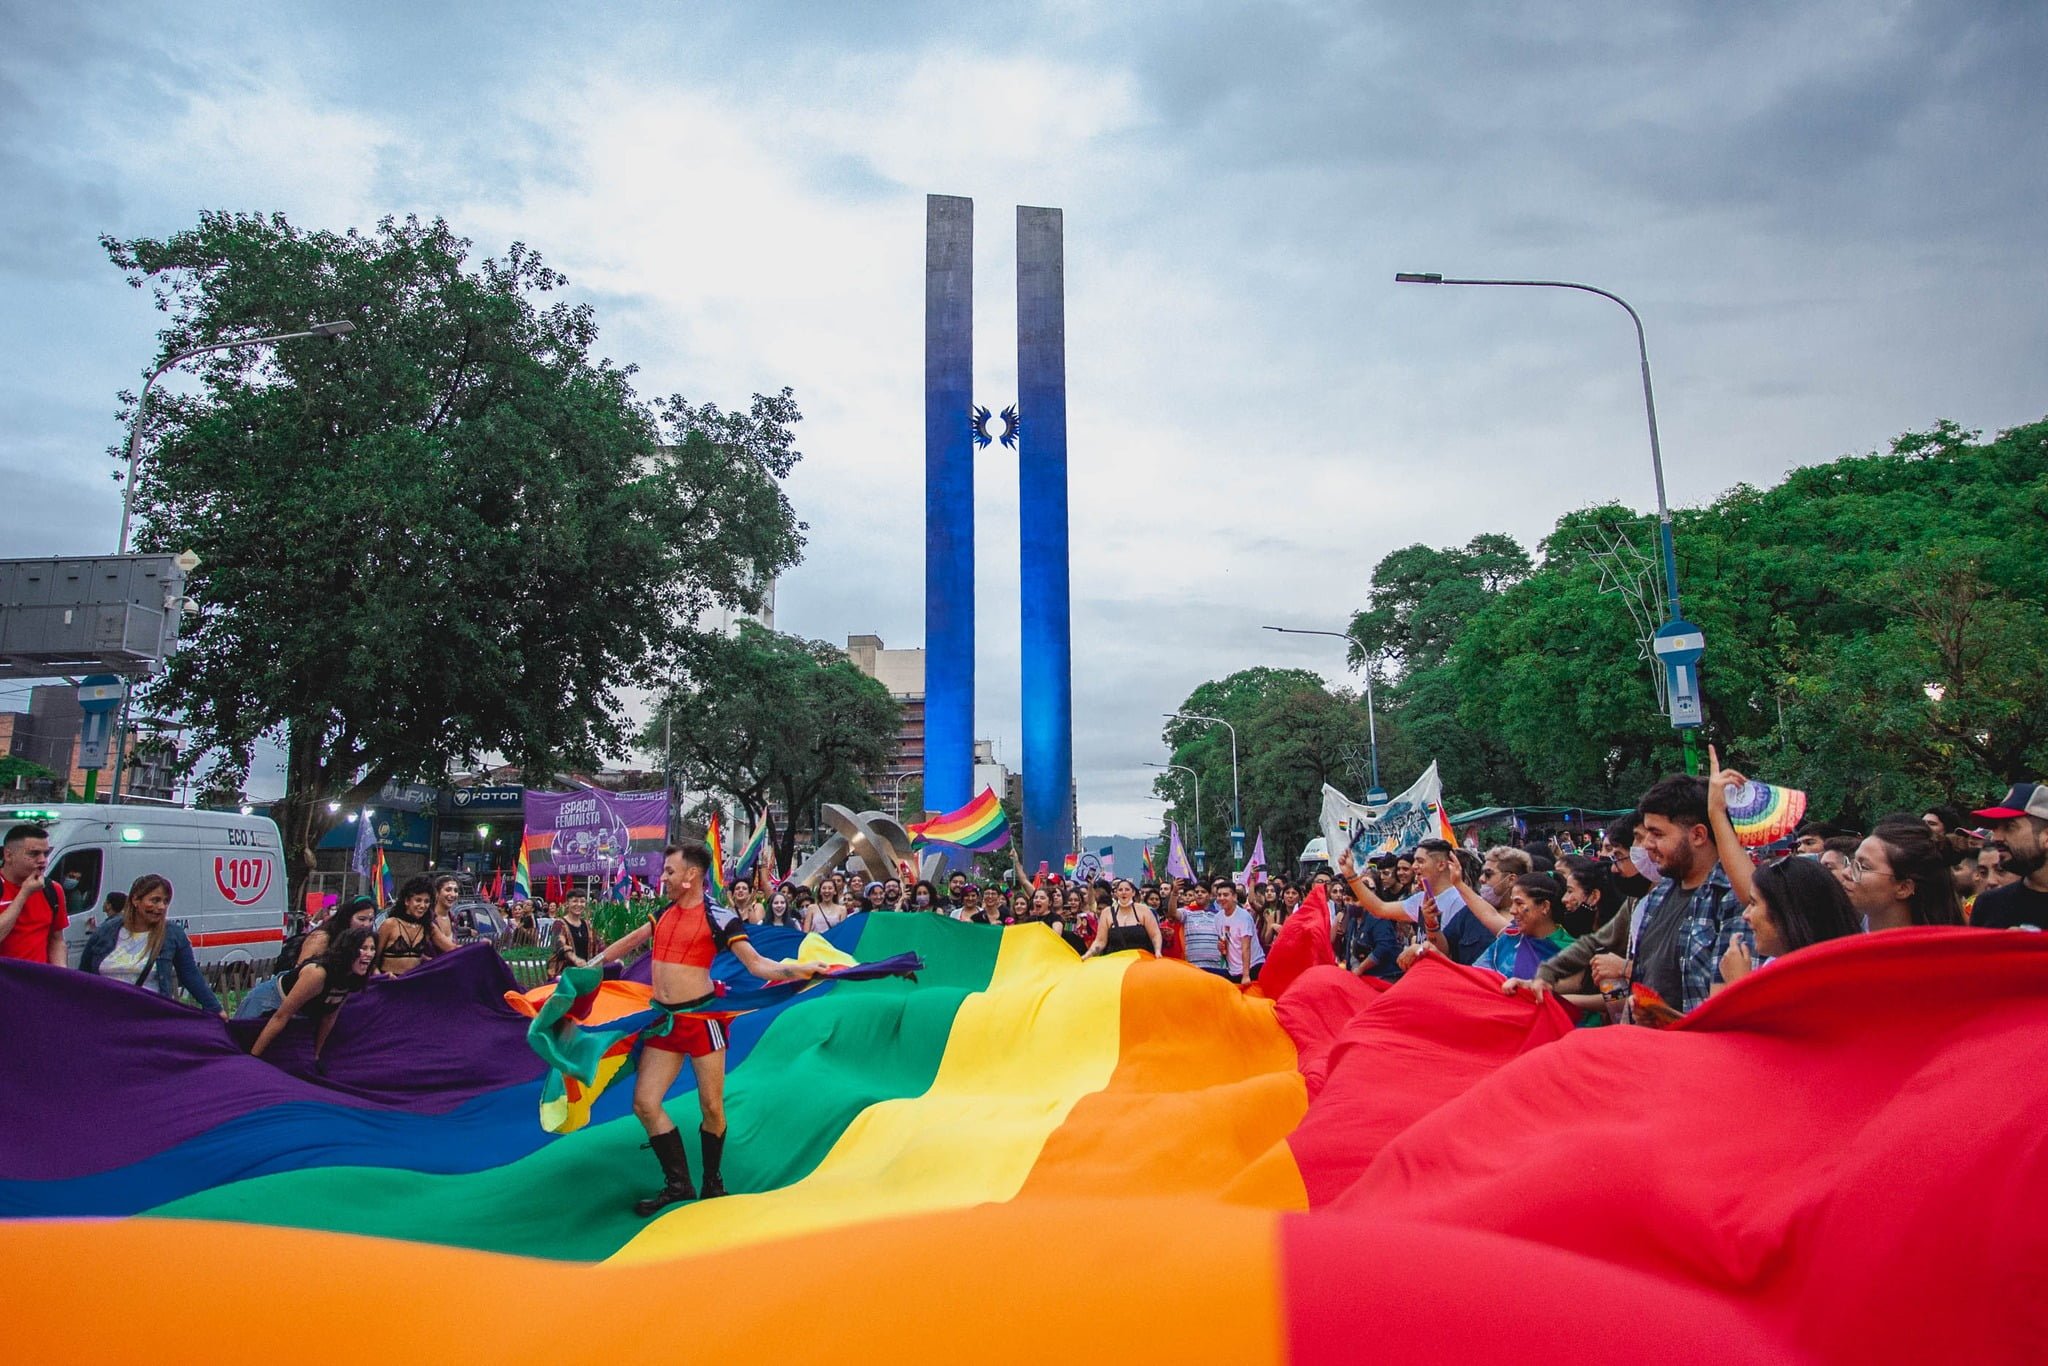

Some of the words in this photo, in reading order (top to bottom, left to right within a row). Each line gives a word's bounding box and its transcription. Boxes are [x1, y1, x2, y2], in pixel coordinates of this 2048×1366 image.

[472, 792, 519, 800] FOTON
[560, 799, 596, 814] ESPACIO
[555, 812, 600, 828] FEMINISTA
[228, 829, 248, 845] ECO
[250, 831, 257, 846] 1
[229, 858, 263, 888] 107
[558, 864, 566, 874] DE
[568, 861, 595, 873] MUJERES
